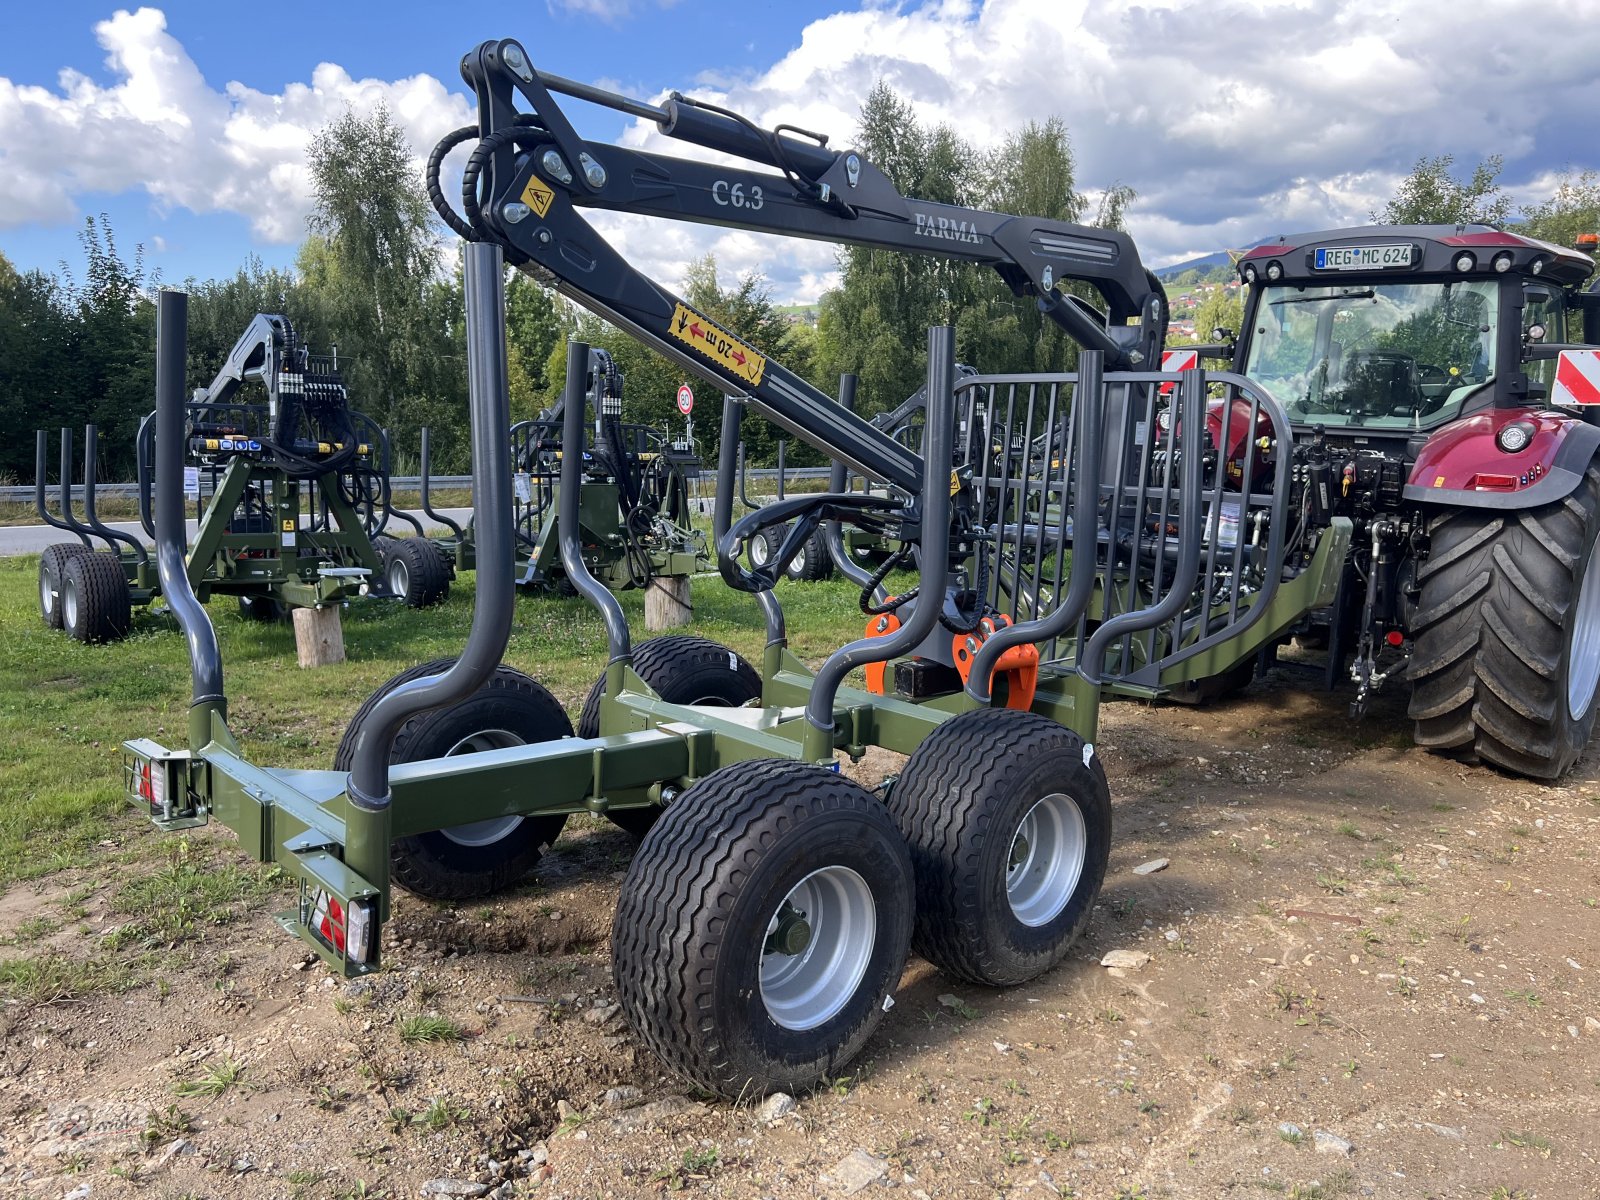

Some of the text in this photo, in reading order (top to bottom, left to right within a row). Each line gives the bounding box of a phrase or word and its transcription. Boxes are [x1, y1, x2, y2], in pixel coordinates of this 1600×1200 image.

[712, 180, 764, 210] C6.3
[914, 213, 980, 244] FARMA
[1326, 247, 1409, 266] REG MC 624
[705, 330, 733, 359] 20 m
